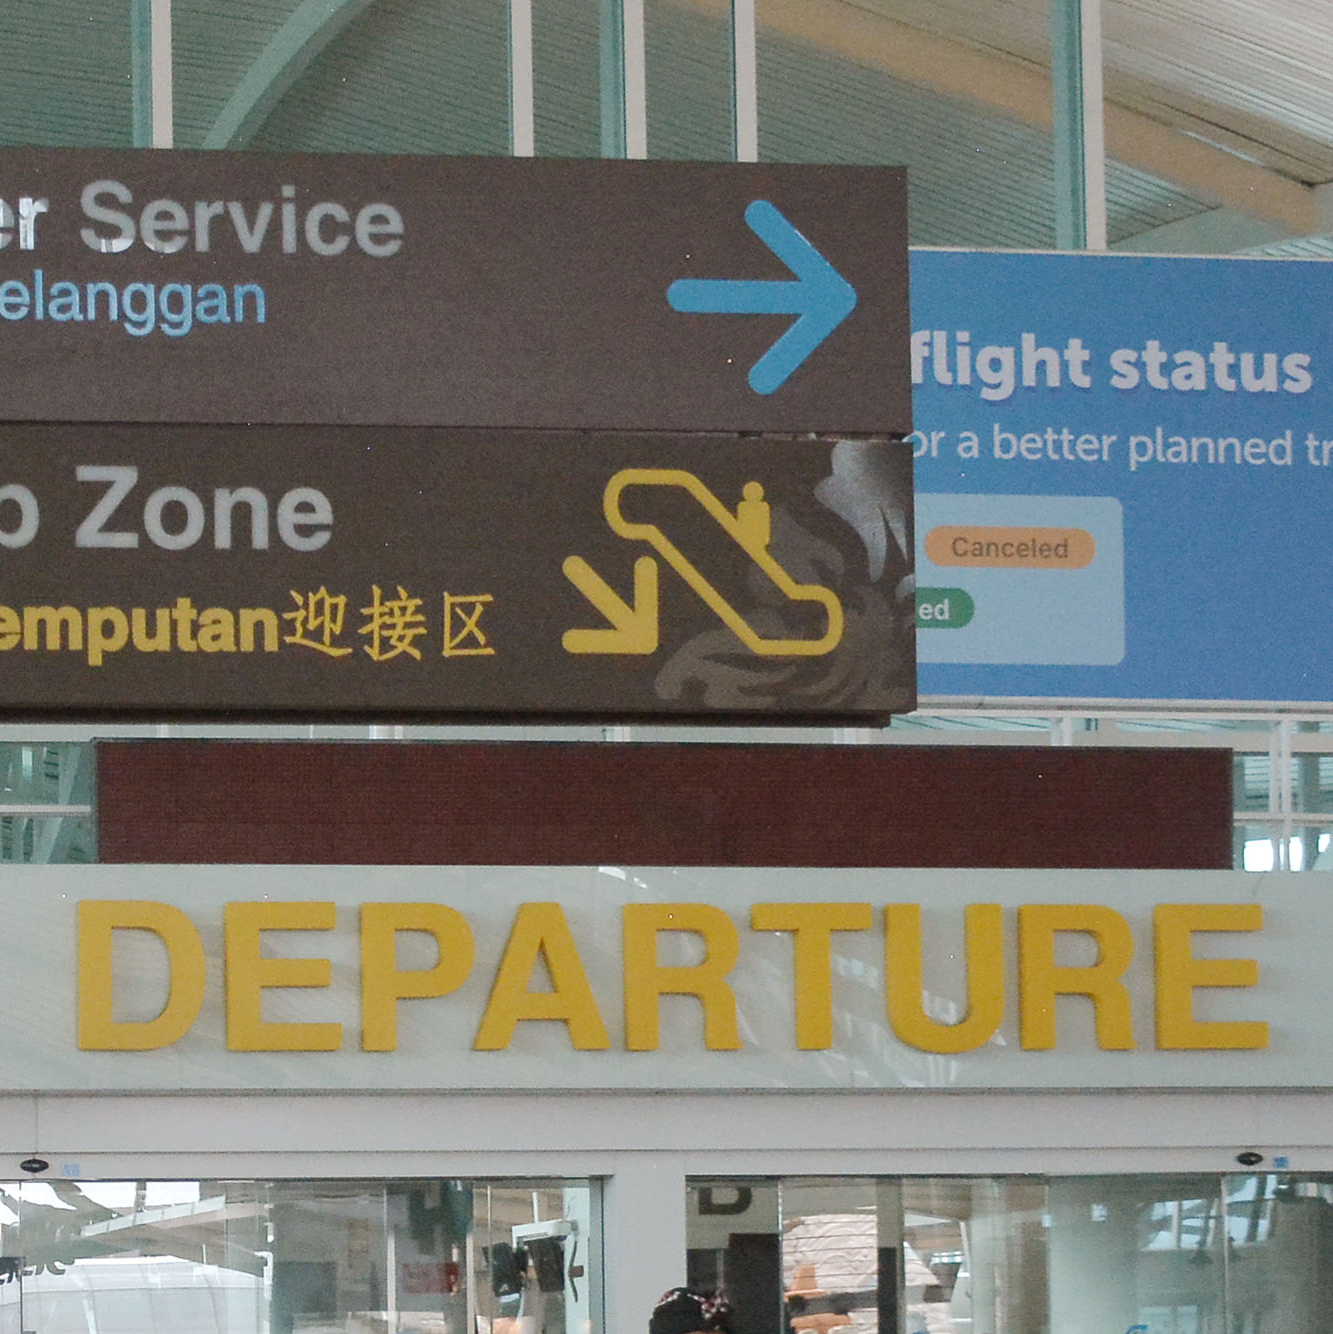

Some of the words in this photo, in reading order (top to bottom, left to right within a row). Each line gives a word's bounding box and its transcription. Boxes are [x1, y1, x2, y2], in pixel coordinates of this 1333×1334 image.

[80, 179, 404, 257] Service
[910, 330, 1091, 402] flight
[1110, 340, 1313, 394] status
[904, 430, 945, 458] or
[956, 431, 979, 459] a
[993, 423, 1117, 461] better
[1130, 427, 1293, 471] planned
[1307, 432, 1333, 467] tr
[75, 465, 334, 553] Zone
[951, 537, 1069, 559] Canceled
[283, 584, 497, 662] 迎接区
[919, 598, 949, 620] ed
[75, 898, 1271, 1056] DEPARTURE
